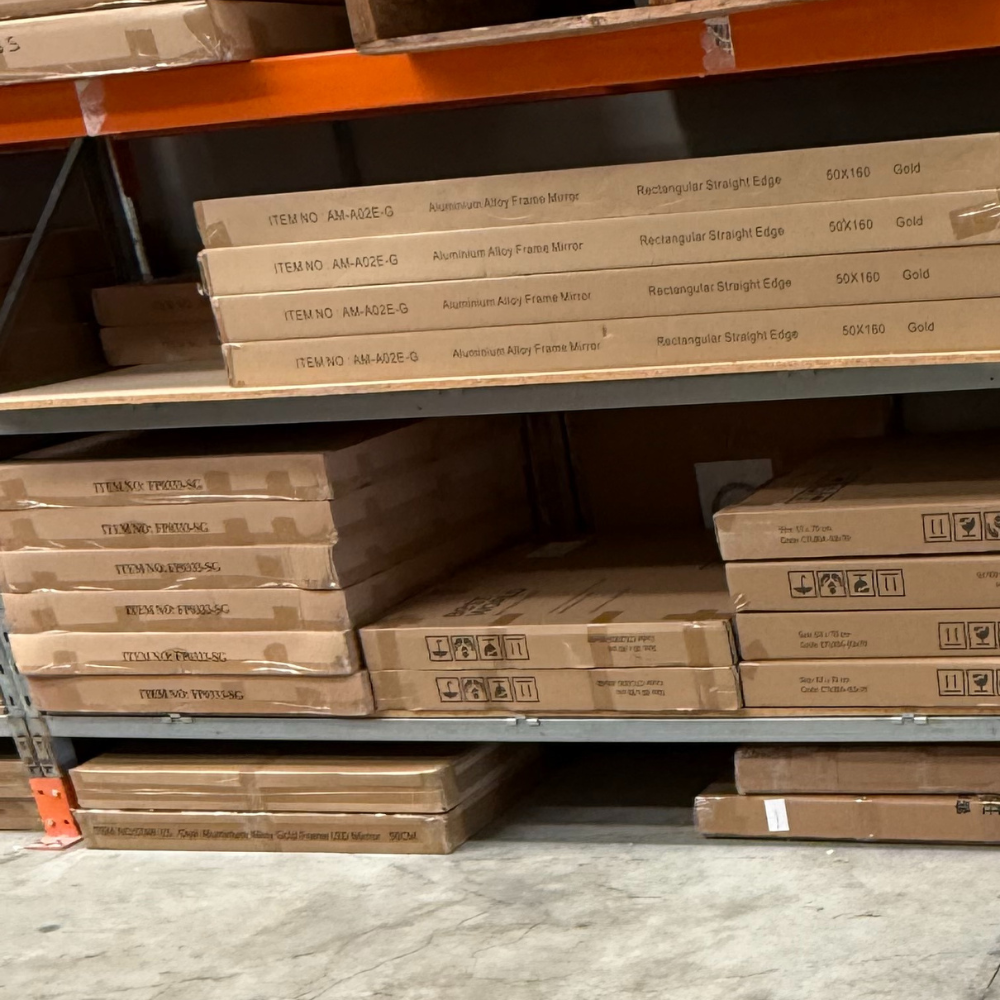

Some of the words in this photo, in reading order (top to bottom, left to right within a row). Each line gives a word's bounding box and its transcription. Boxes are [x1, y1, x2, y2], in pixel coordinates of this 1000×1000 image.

[893, 162, 921, 175] Gold
[636, 181, 703, 196] Rectangular
[706, 176, 750, 191] Straight
[752, 174, 782, 188] Edge
[429, 201, 483, 212] Aluminium
[484, 197, 509, 209] Alloy
[511, 195, 546, 206] Frame
[547, 192, 580, 204] Mirror
[268, 214, 298, 226] ITEM
[327, 205, 394, 222] AM-A02E-G
[895, 215, 923, 228] Gold
[639, 231, 706, 246] Rectangular
[708, 228, 753, 242] Straight
[755, 226, 785, 239] Edge
[432, 249, 485, 261] Aluminium
[488, 246, 513, 258] Alloy
[515, 243, 549, 254] Frame
[551, 241, 584, 252] Mirror
[274, 261, 304, 274] ITEM
[332, 254, 398, 270] AM-A02E-G
[836, 271, 880, 284] 50X160
[902, 268, 930, 280] Gold
[648, 282, 714, 297] Rectangular
[717, 278, 761, 293] Straight
[763, 277, 792, 290] Edge
[443, 298, 496, 310] Aluminium
[497, 296, 522, 307] Alloy
[524, 293, 558, 304] Frame
[560, 291, 592, 302] Mirror
[284, 308, 313, 321] ITEM
[342, 302, 409, 318] AM-A02E-G
[842, 323, 886, 336] 50X160
[907, 321, 935, 333] Gold
[657, 332, 721, 347] Rectangular
[724, 329, 768, 344] Straight
[770, 329, 799, 341] Edge
[452, 347, 505, 358] Aluminium
[507, 345, 532, 356] Alloy
[533, 343, 568, 354] Frame
[569, 341, 601, 352] Mirror
[295, 356, 325, 369] ITEM
[353, 351, 419, 365] AM-A02E-G
